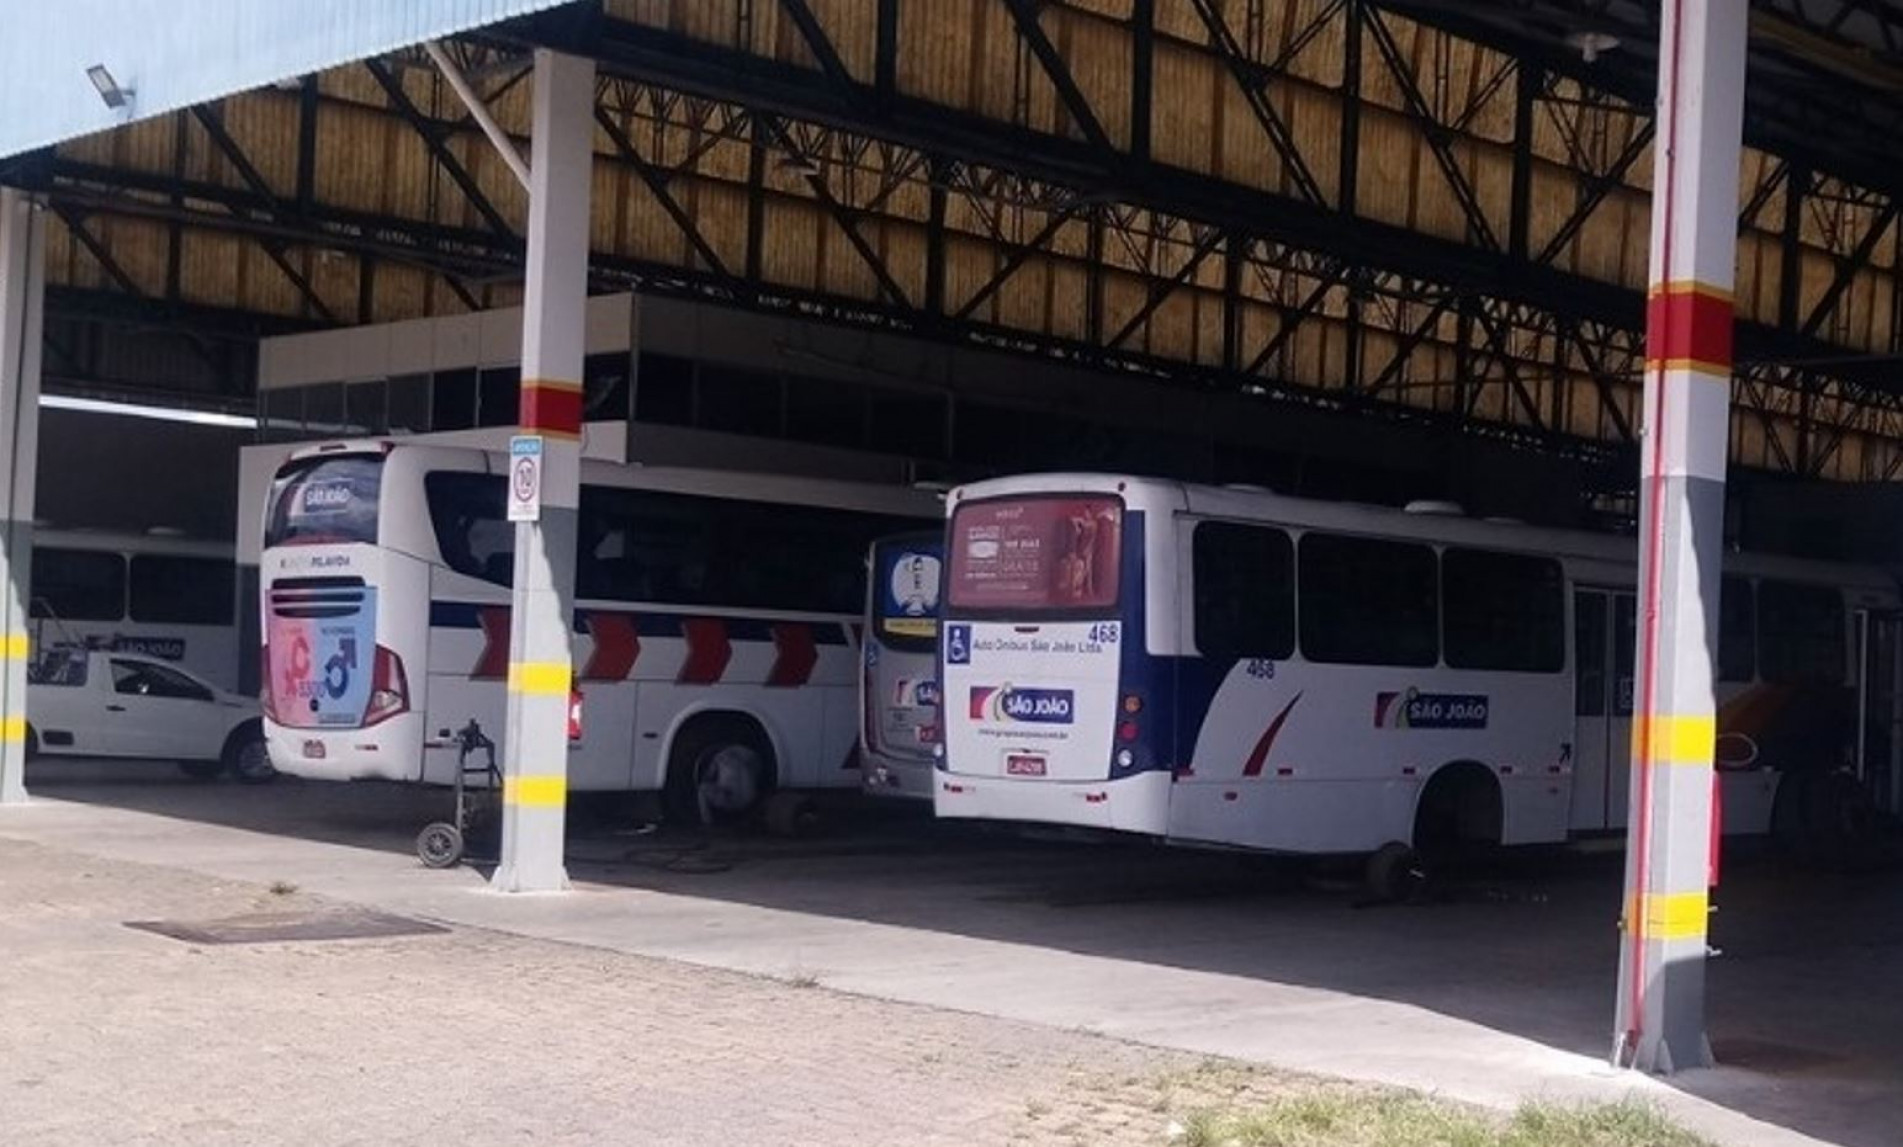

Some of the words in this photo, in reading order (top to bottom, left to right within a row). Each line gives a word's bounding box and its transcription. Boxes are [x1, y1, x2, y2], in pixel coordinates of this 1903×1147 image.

[1087, 622, 1119, 644] 468
[1247, 659, 1275, 680] 468
[1006, 694, 1034, 714] SÃO
[1034, 695, 1069, 715] JOÃO
[1410, 698, 1442, 719] SÃO
[1446, 698, 1486, 720] JOÃO
